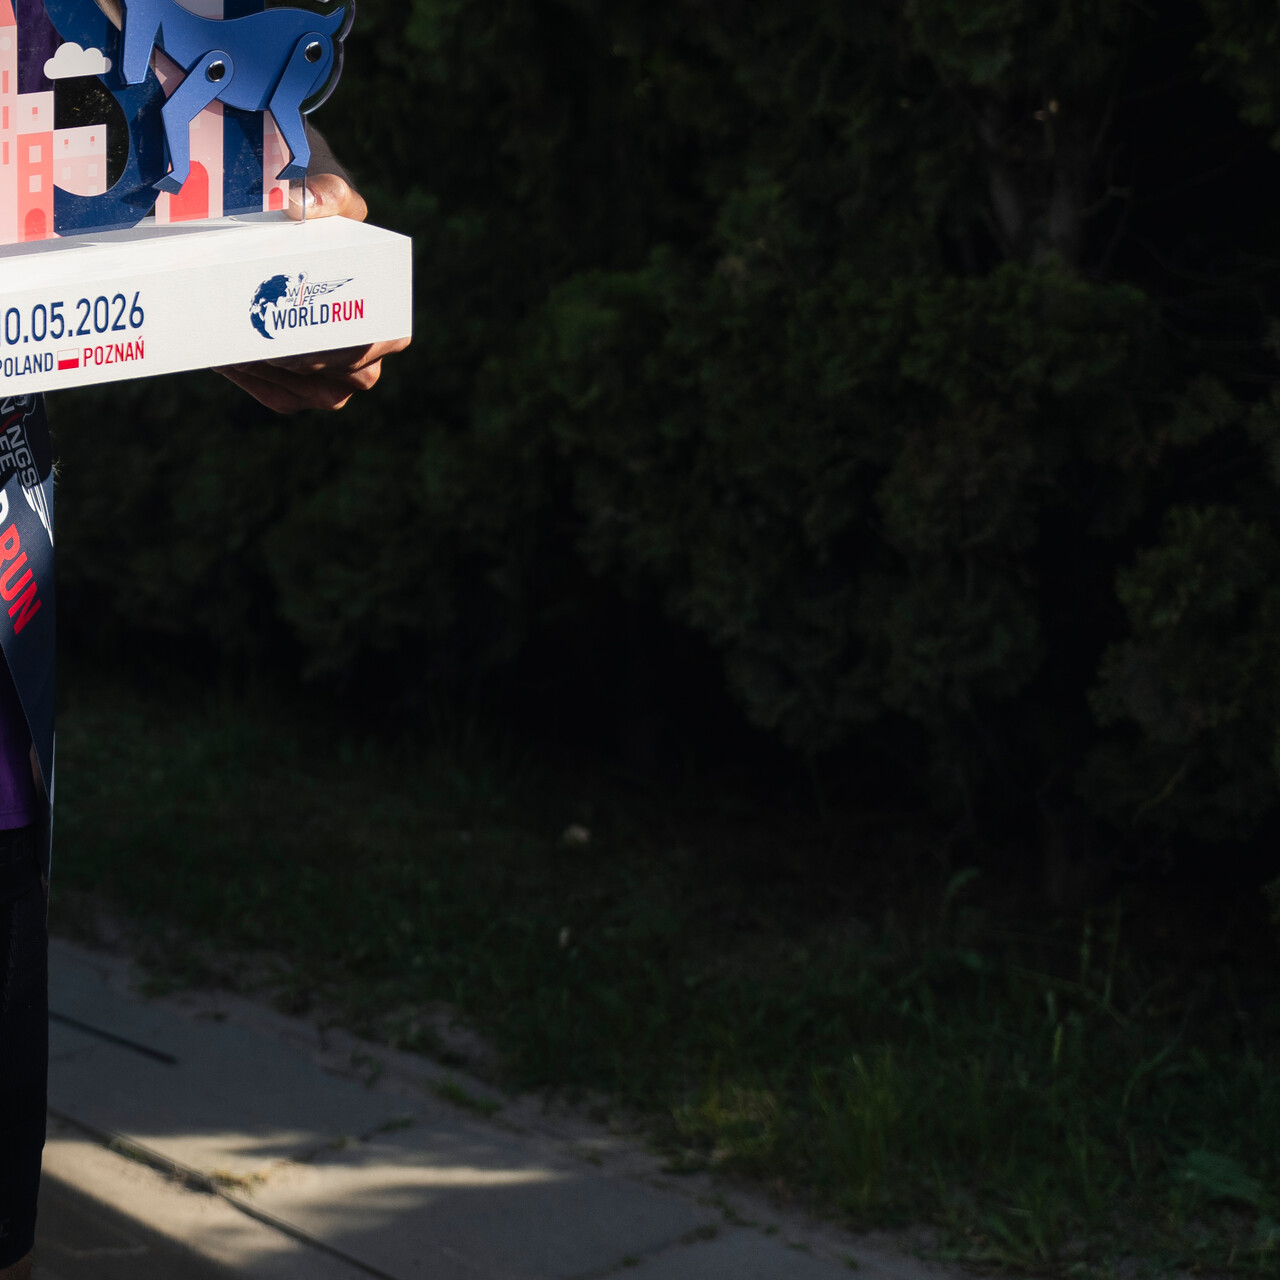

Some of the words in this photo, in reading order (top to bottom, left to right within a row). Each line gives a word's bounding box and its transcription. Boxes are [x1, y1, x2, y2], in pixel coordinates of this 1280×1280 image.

[272, 304, 330, 330] WORLD
[332, 299, 364, 323] RUN
[83, 336, 145, 368] POZNAŃ
